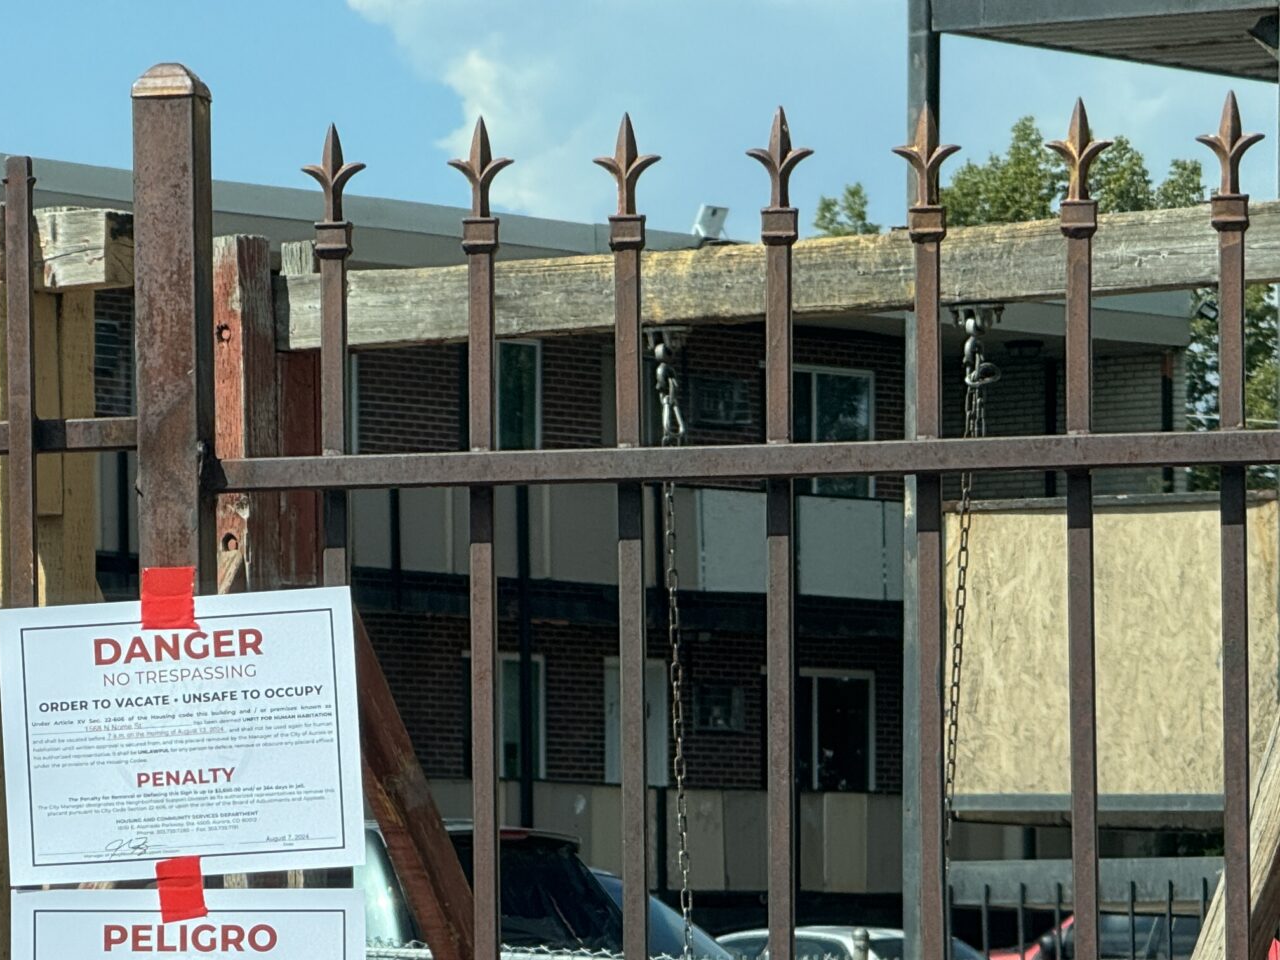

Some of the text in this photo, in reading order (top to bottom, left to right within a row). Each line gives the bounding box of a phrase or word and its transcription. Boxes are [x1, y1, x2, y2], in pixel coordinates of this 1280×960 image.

[94, 628, 264, 666] DANGER
[103, 663, 257, 687] NO TRESPASSING
[39, 685, 323, 713] ORDER TO VACATE UNSAFE TO OCCUPY
[137, 767, 235, 788] PENALTY
[103, 924, 278, 952] PELIGRO
